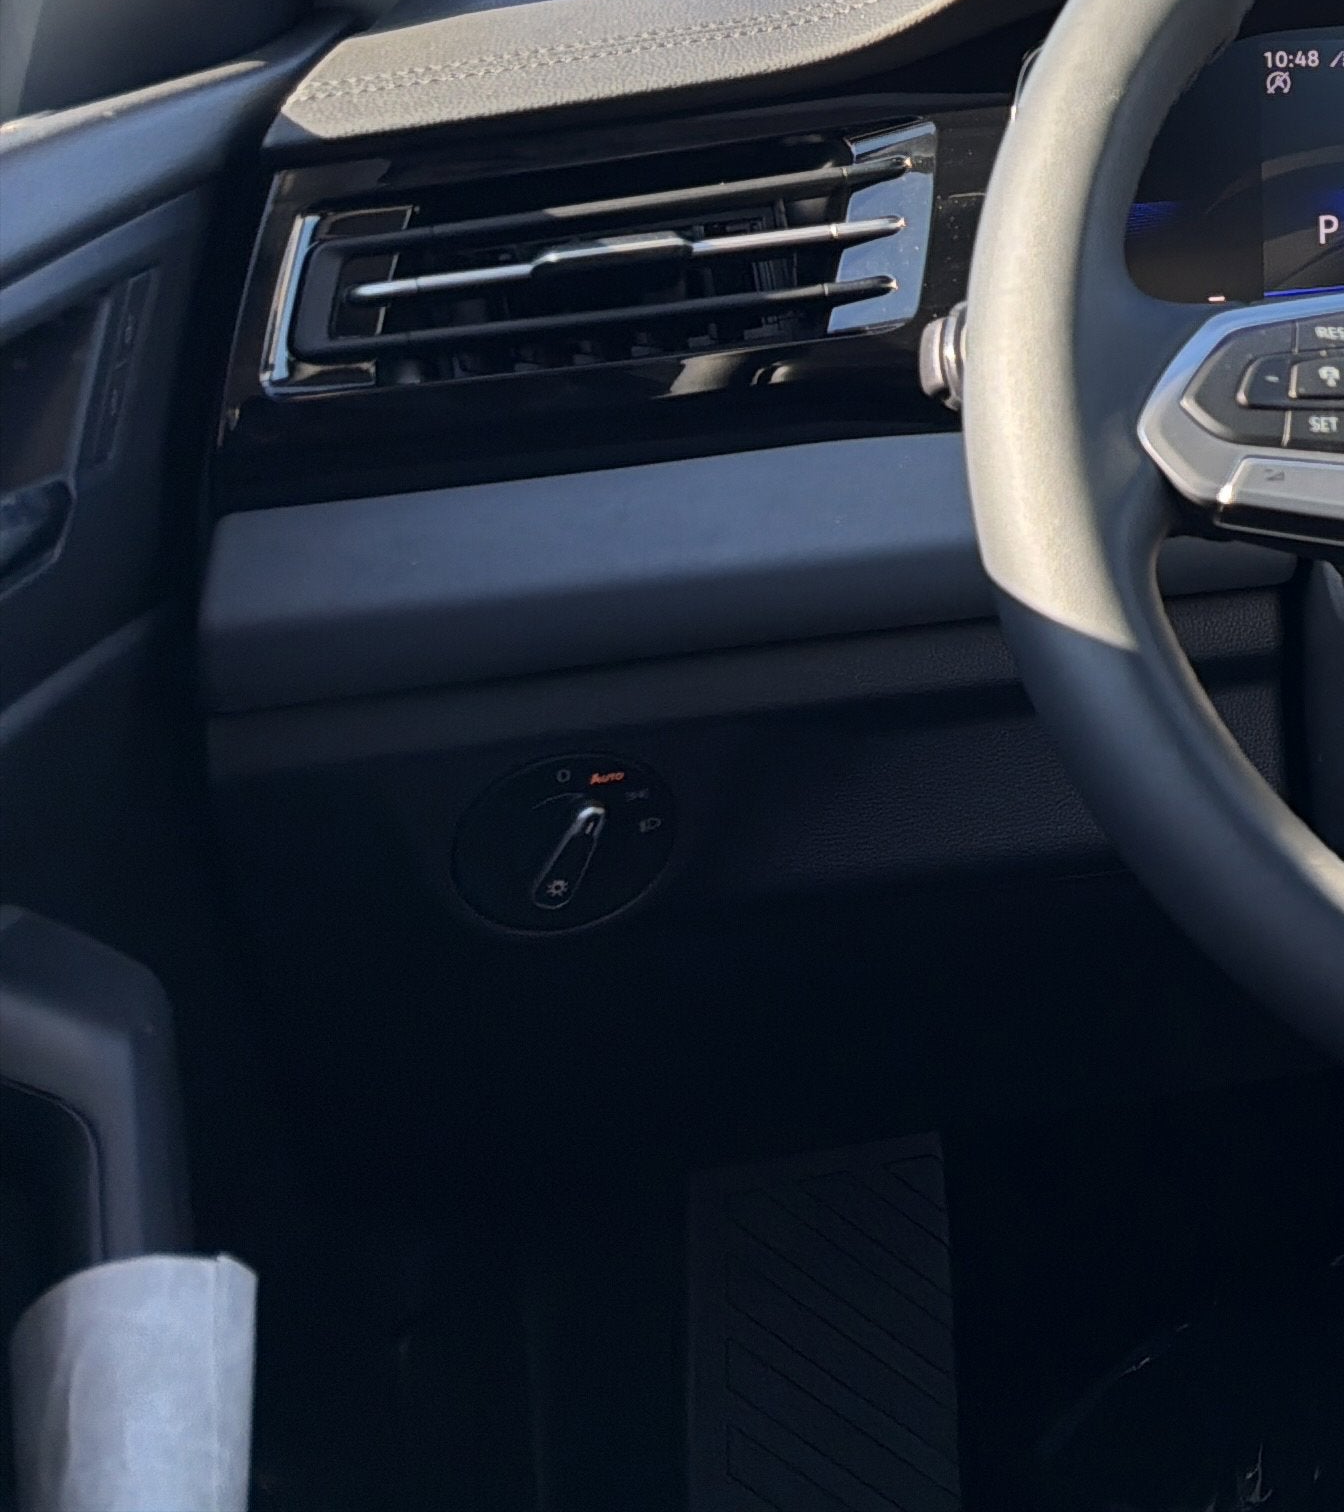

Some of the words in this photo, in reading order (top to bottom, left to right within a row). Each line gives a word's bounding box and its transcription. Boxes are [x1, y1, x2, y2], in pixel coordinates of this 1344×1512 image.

[1263, 50, 1320, 68] 10:48
[1318, 214, 1339, 245] P
[1307, 415, 1339, 433] SET
